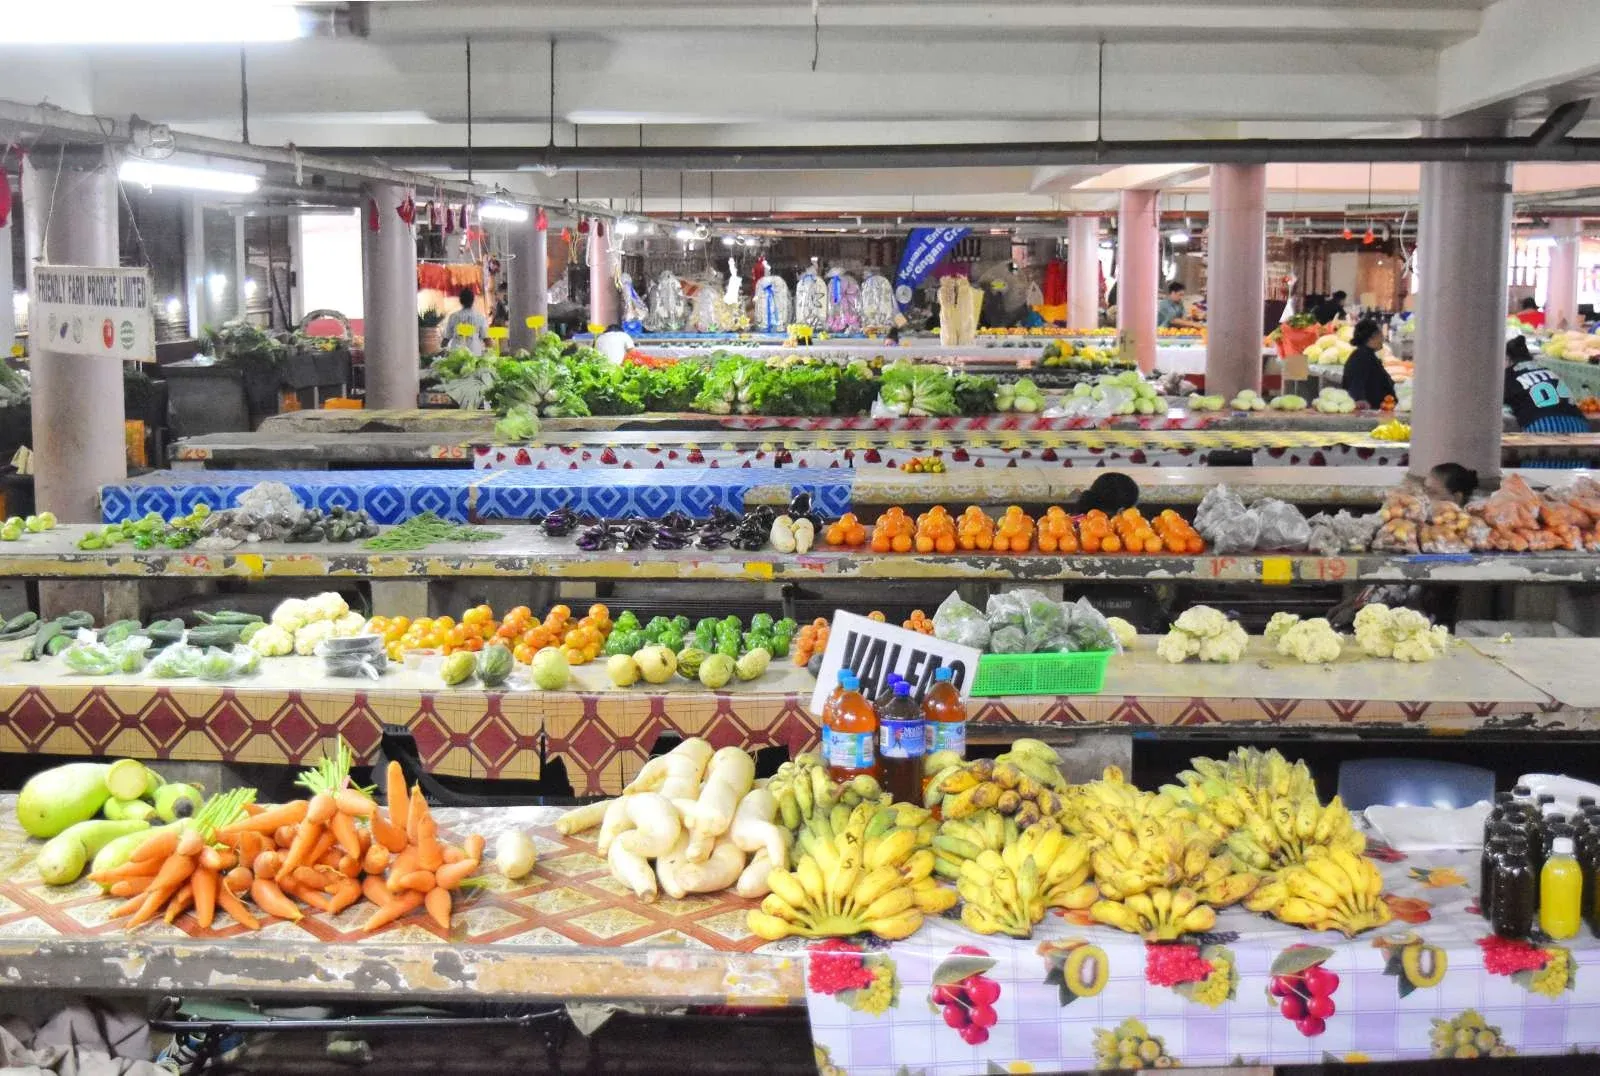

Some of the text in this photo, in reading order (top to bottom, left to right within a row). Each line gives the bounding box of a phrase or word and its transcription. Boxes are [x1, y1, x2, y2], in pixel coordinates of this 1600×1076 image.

[38, 273, 146, 309] FRIENDLY FARM PRODUCE LIMITED
[1316, 558, 1347, 580] 19
